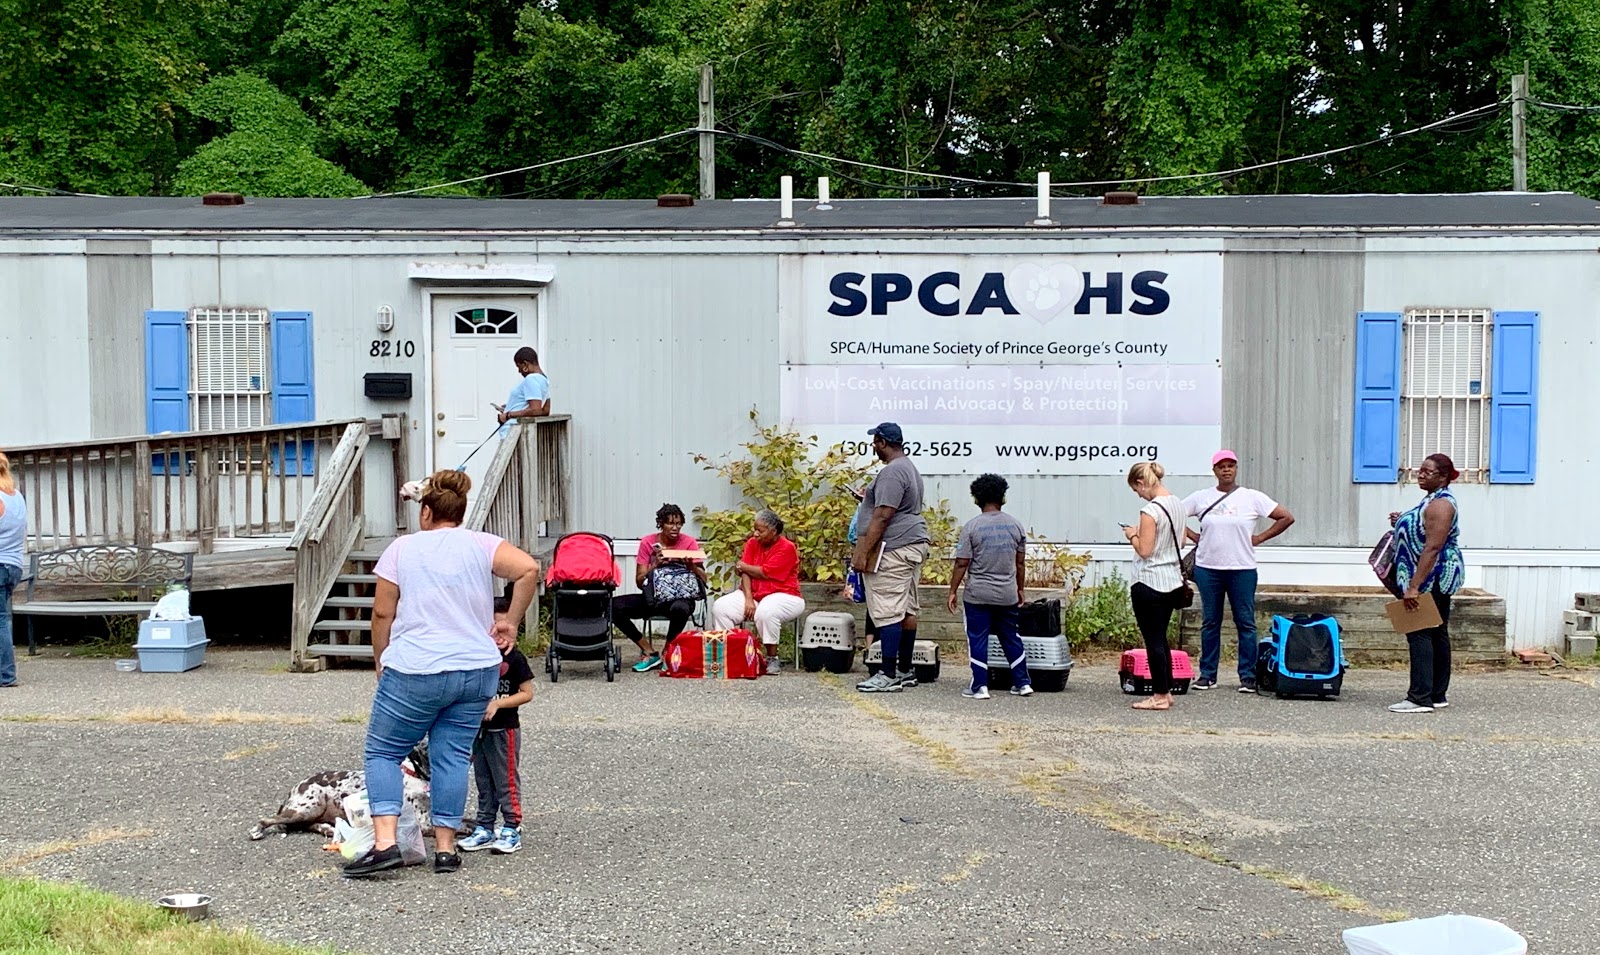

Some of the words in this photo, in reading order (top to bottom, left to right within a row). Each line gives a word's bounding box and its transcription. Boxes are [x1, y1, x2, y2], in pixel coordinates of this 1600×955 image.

[827, 271, 1021, 316] SPCA
[1074, 270, 1170, 316] HS
[369, 340, 415, 357] 8210
[830, 341, 930, 355] SPCA/Humane
[933, 341, 982, 357] Society
[985, 340, 1000, 354] of
[1002, 341, 1044, 354] Prince
[1047, 341, 1111, 357] George's
[1115, 341, 1168, 355] County
[805, 376, 884, 390] Low-Cost
[889, 376, 995, 390] Vaccinations
[1013, 376, 1119, 393] Spay/Neuter
[1126, 376, 1197, 391] Services
[869, 396, 928, 410] Animal
[934, 396, 1015, 414] Advocacy
[1022, 396, 1034, 411] &
[1040, 396, 1128, 411] Protection
[841, 440, 879, 457] (301
[900, 441, 972, 456] 62-5625
[995, 444, 1158, 460] www.pgspca.org
